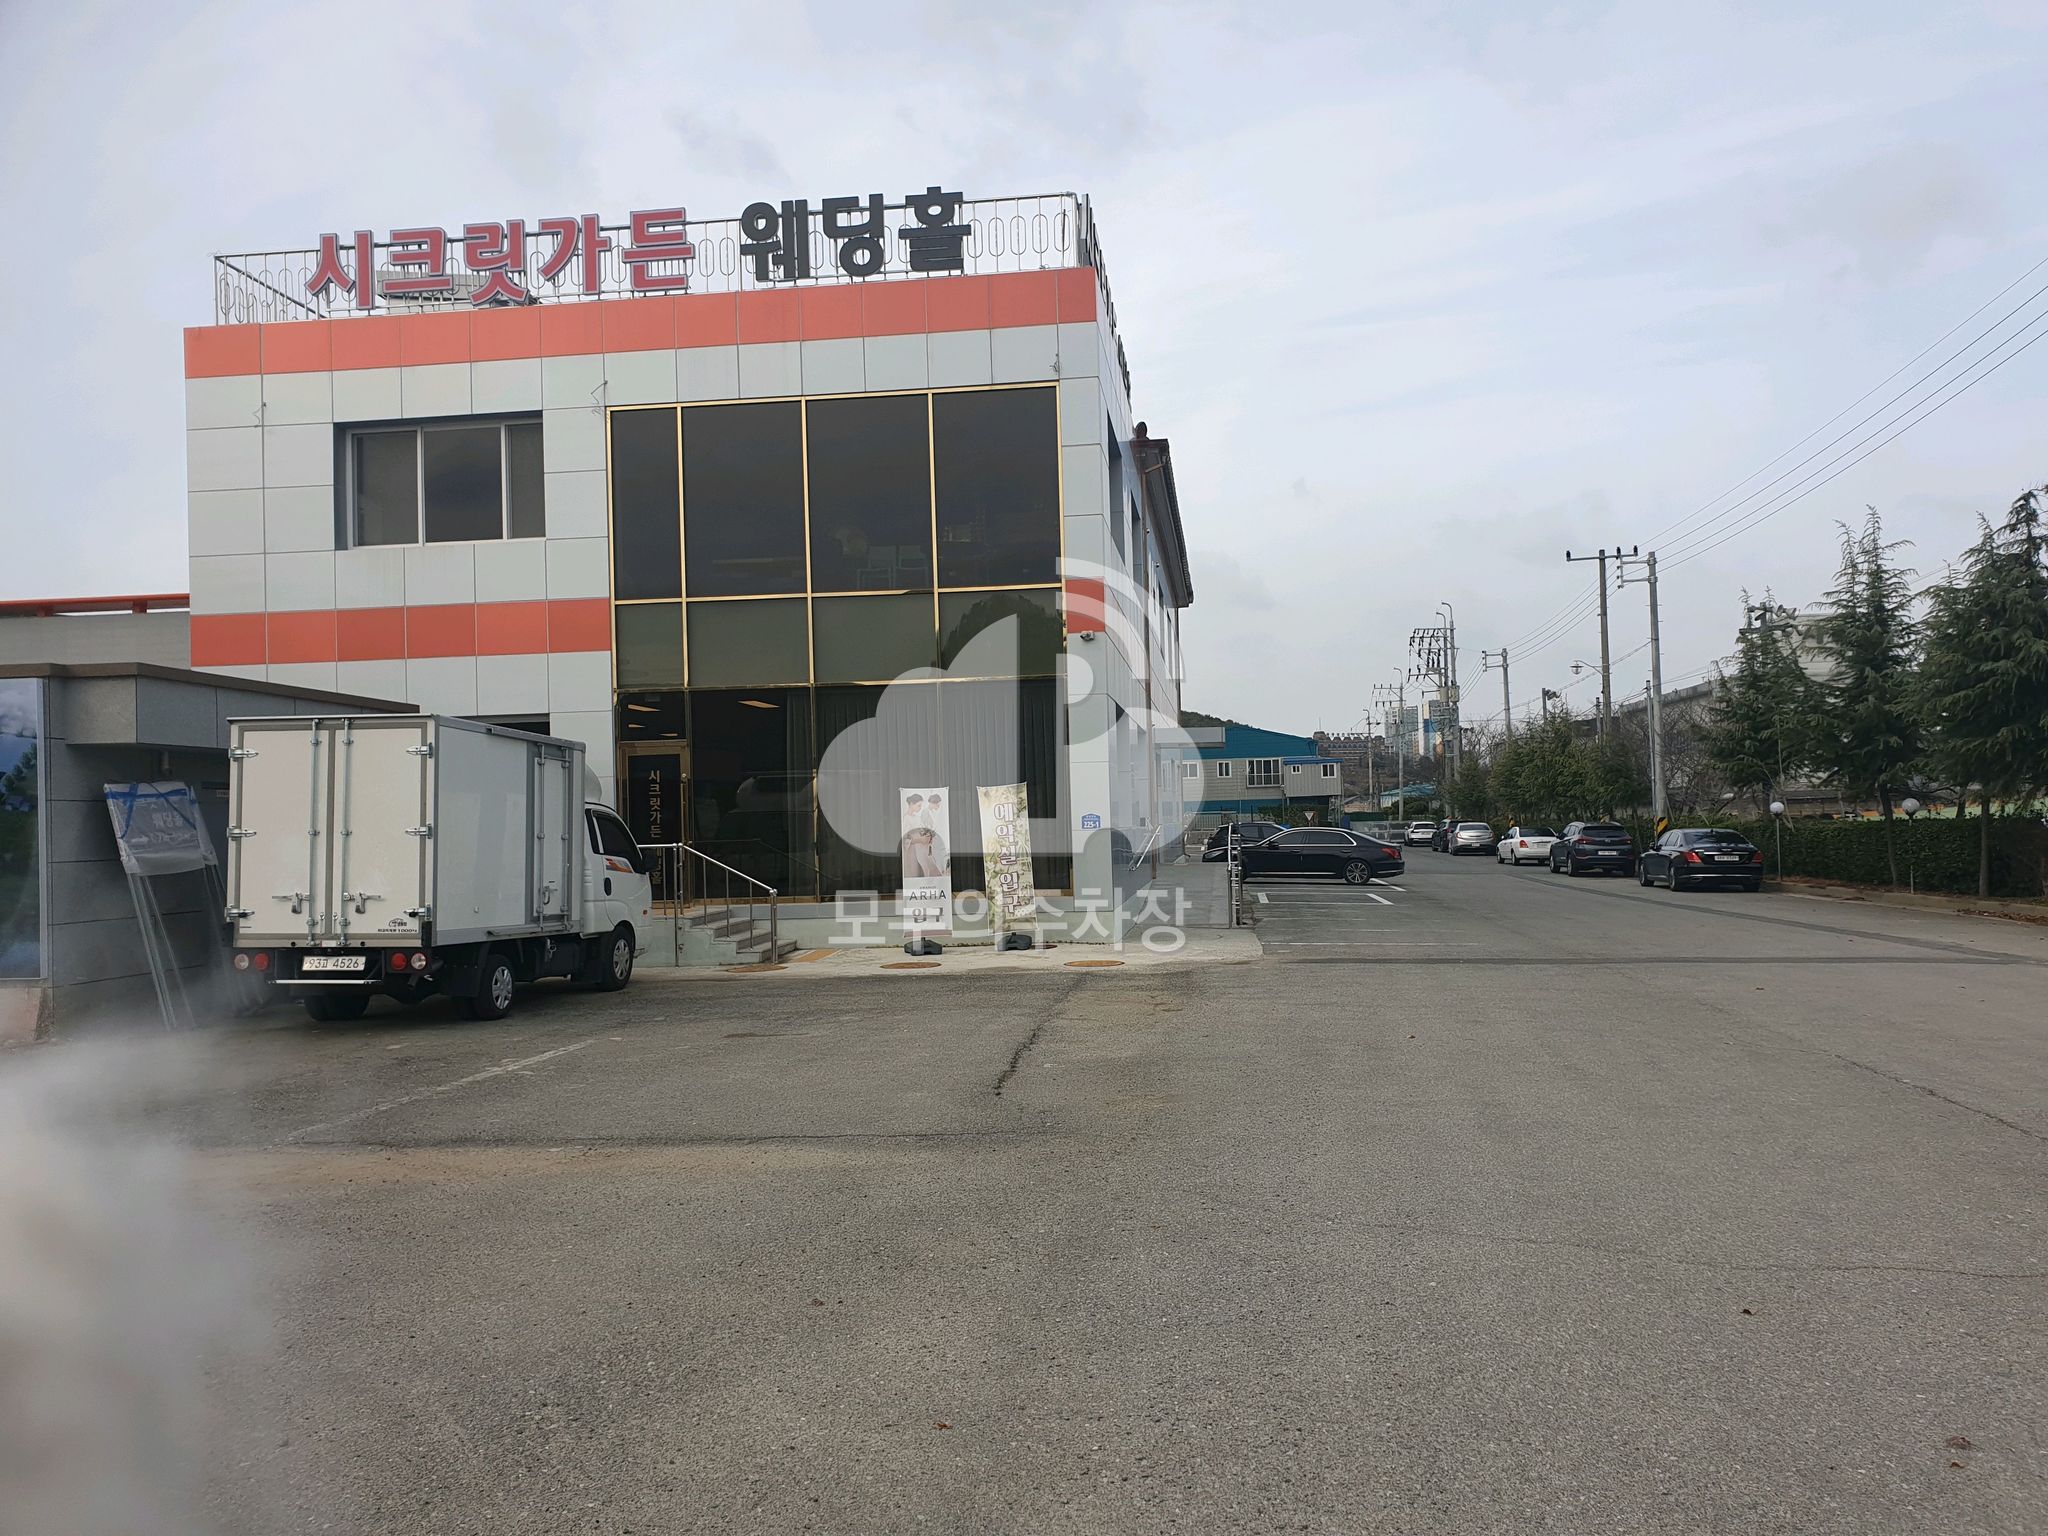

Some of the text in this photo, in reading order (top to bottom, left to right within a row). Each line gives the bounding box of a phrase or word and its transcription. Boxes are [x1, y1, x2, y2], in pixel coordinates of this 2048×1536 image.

[305, 185, 972, 310] 시크릿가든 웨딩홀
[648, 769, 663, 838] 시크릿가든
[993, 802, 1021, 915] 예약실 입구
[909, 889, 947, 901] ARHA
[911, 906, 944, 924] 입구
[332, 957, 360, 969] 4526
